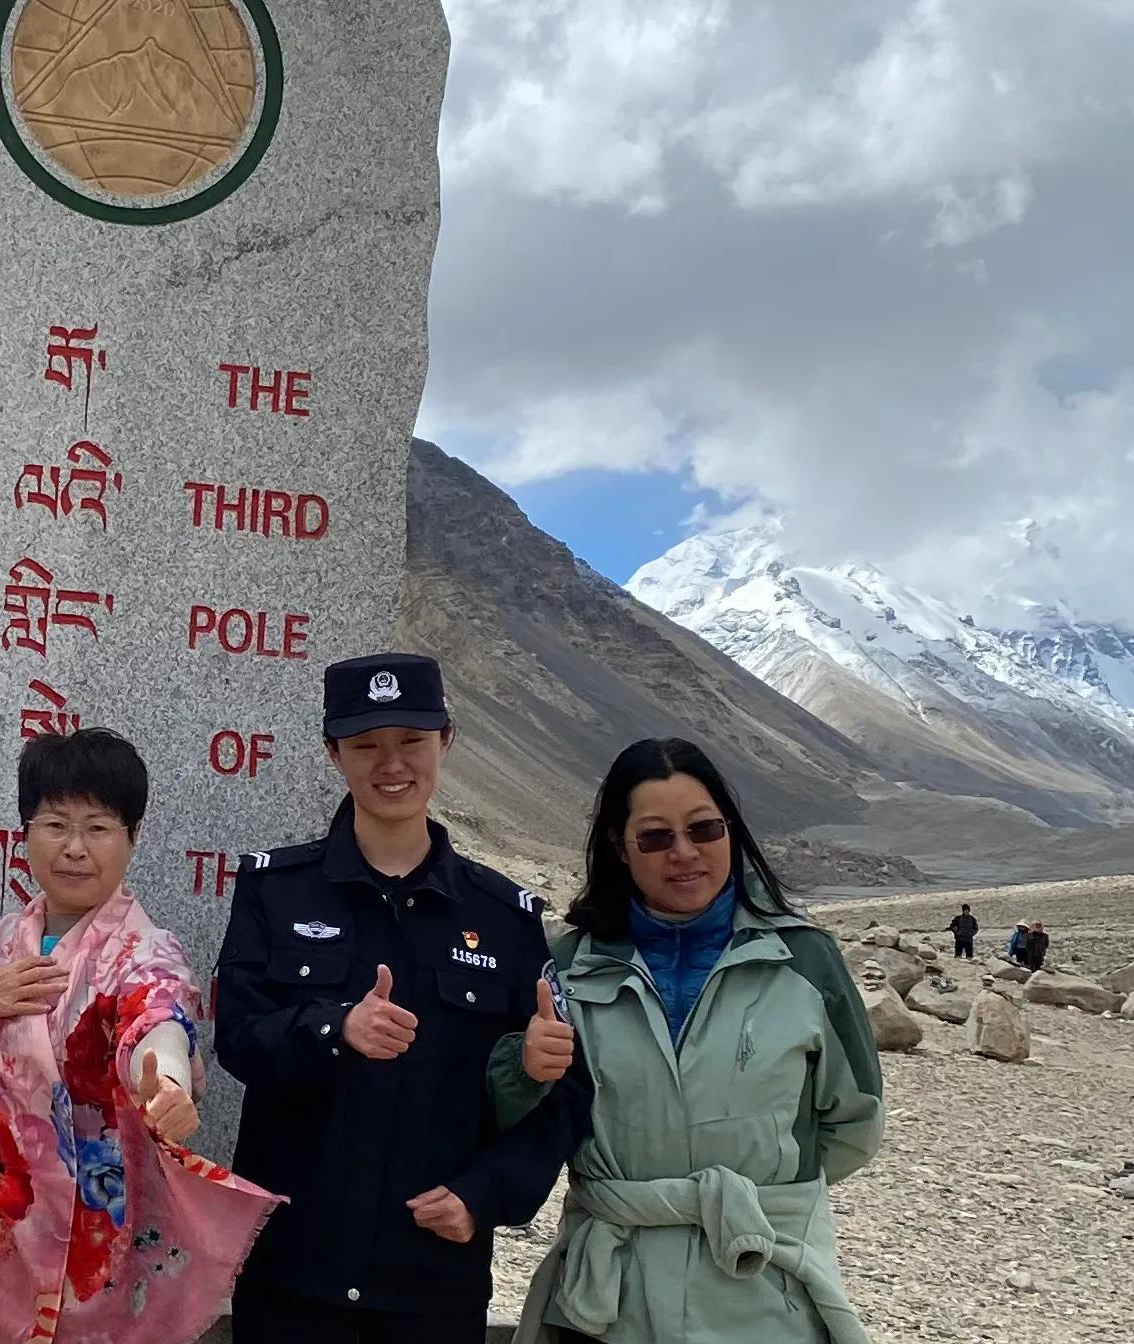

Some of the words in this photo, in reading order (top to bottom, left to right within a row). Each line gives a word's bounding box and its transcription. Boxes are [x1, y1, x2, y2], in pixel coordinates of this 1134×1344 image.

[219, 363, 312, 417] THE
[183, 482, 330, 540] THIRD
[187, 605, 310, 658] POLE
[209, 730, 275, 777] OF
[185, 850, 238, 897] TH
[451, 947, 497, 969] 115678
